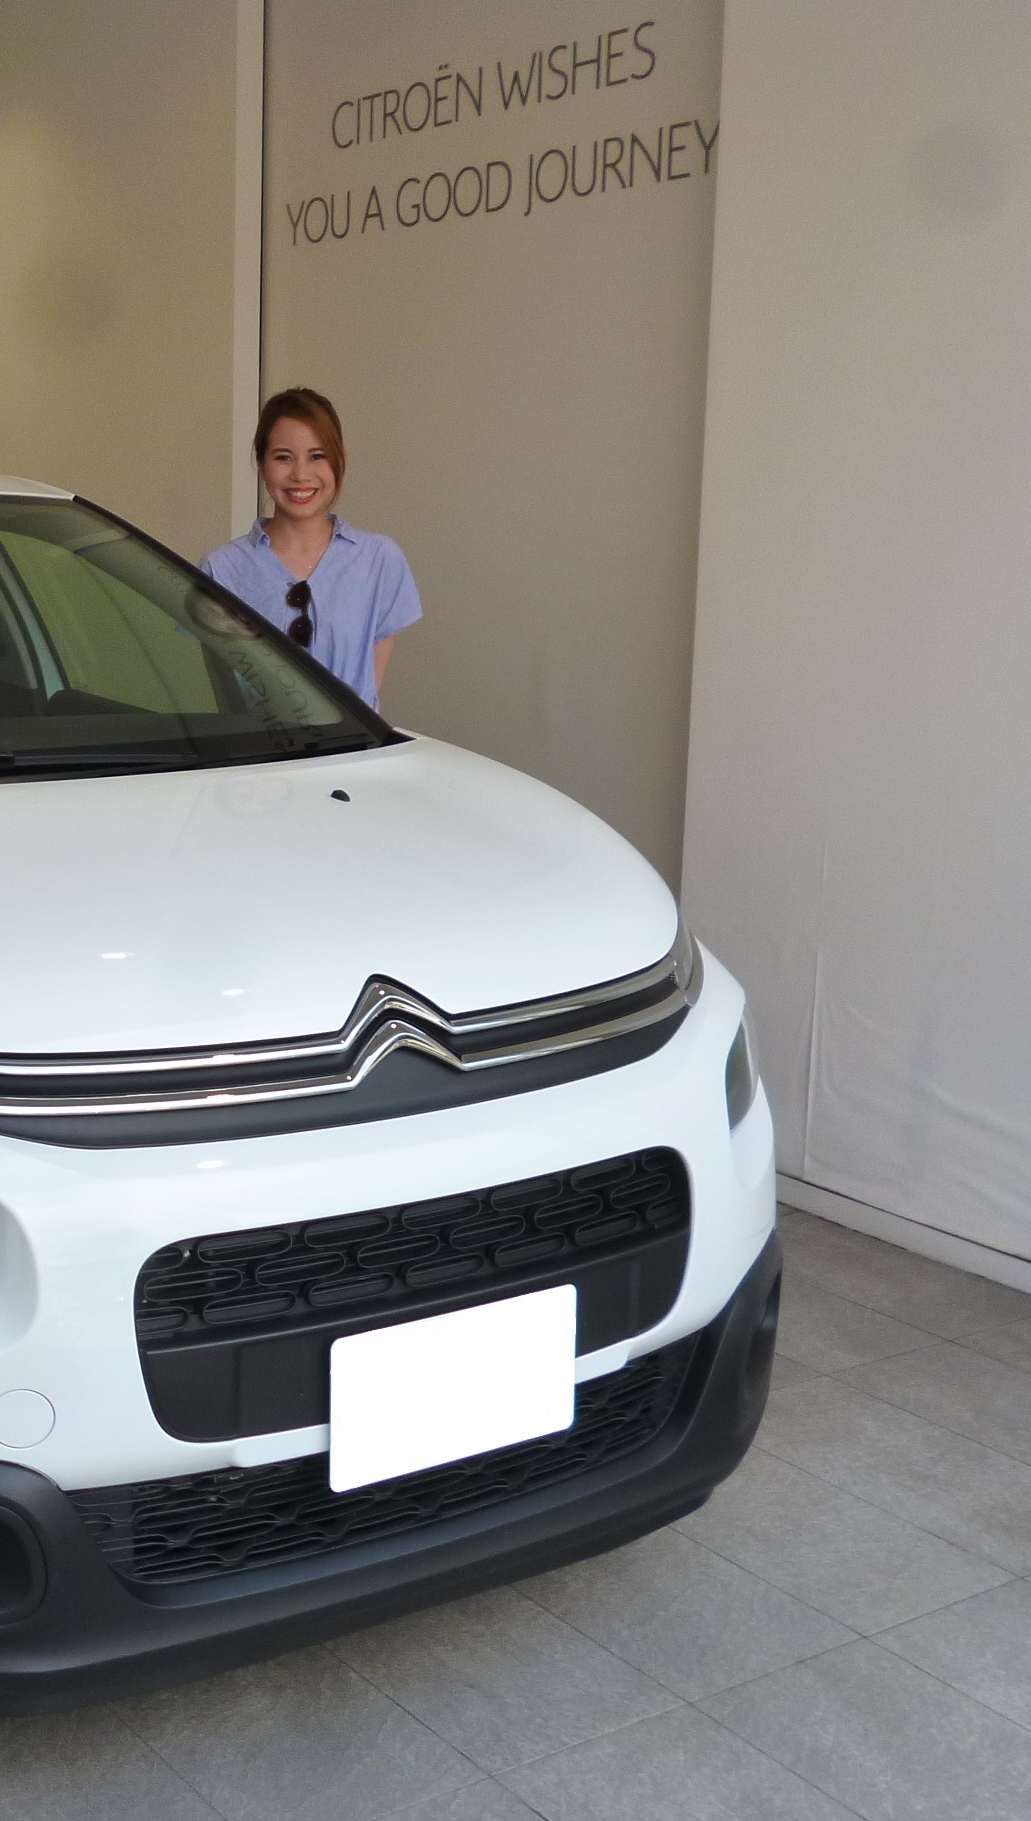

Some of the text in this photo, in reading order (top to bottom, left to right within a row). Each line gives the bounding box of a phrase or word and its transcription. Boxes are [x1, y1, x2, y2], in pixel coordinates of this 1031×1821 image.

[332, 21, 657, 149] CITROËN WISHES
[286, 118, 720, 246] YOU A GOOD JOURNEY
